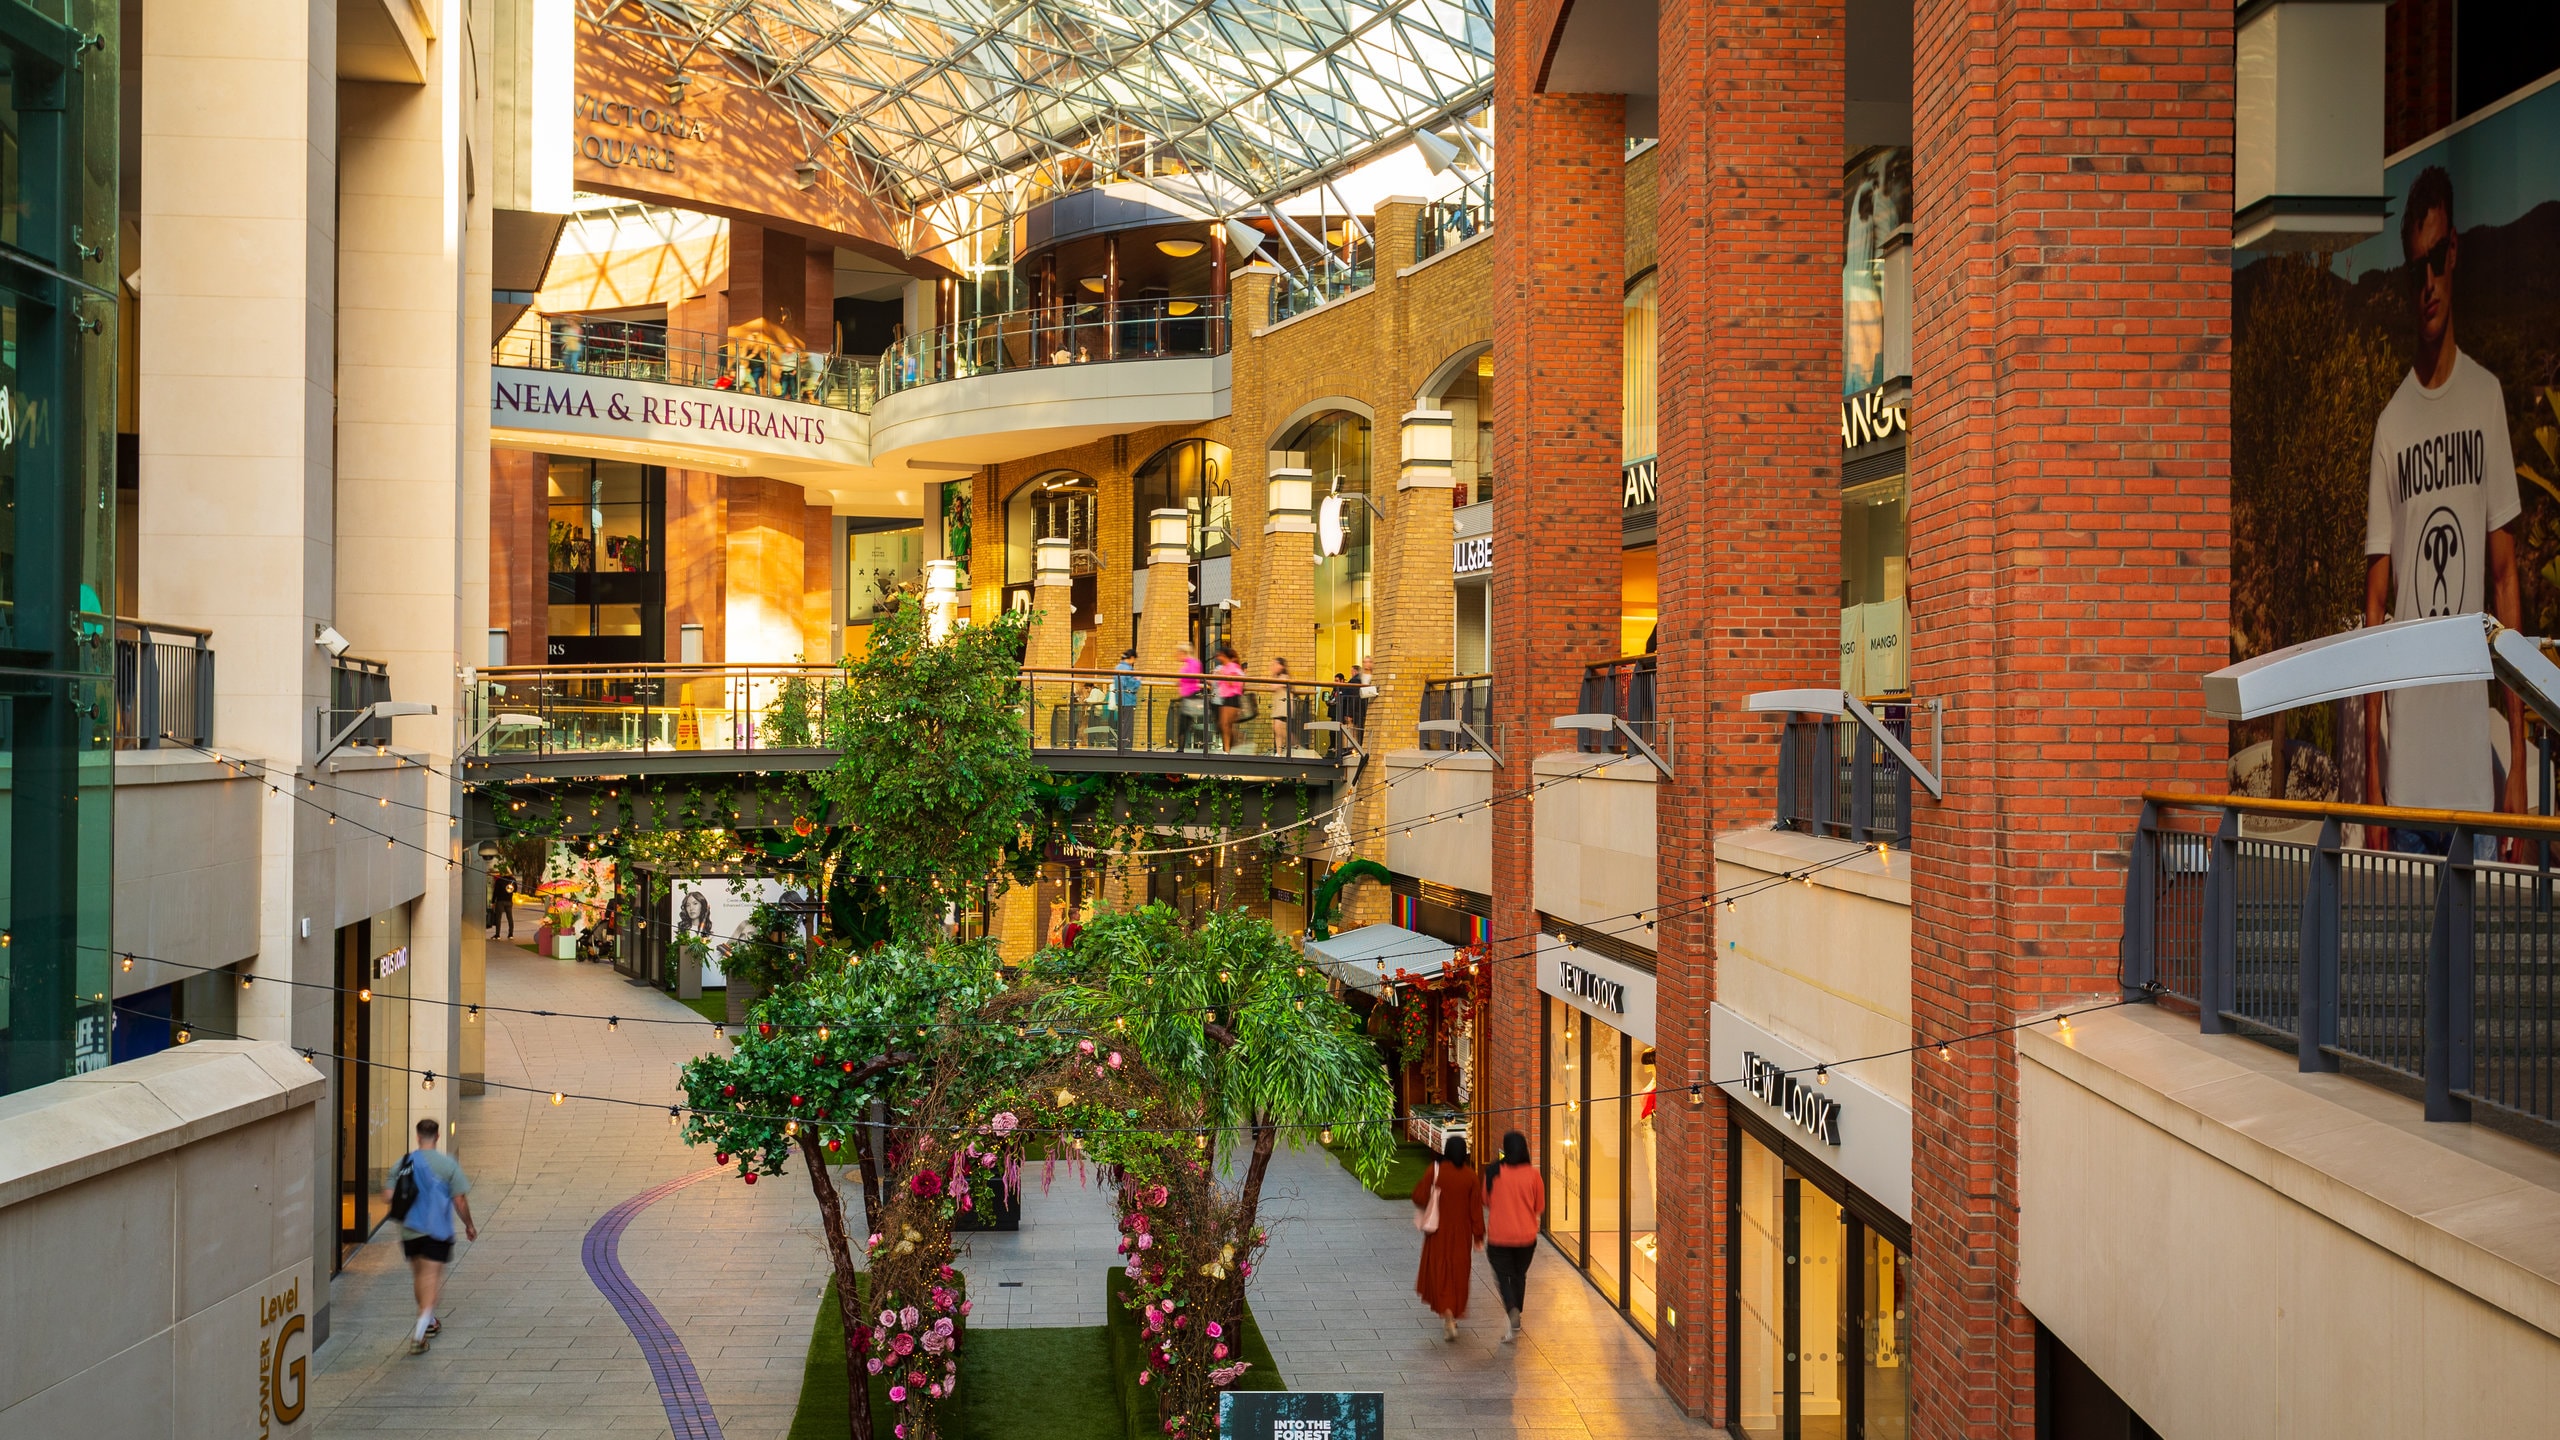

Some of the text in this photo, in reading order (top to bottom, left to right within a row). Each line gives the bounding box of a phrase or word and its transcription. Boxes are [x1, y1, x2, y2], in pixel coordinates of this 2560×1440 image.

[574, 94, 705, 142] VICTORIA
[494, 381, 825, 444] NEMA & RESTAURANTS
[1624, 461, 1658, 509] AN
[2397, 429, 2484, 504] MOSCHINO
[549, 644, 565, 655] RS
[1870, 634, 1897, 651] MANGO
[1559, 962, 1619, 1014] NEW LOOK
[1742, 1051, 1833, 1146] NEW LOOK
[260, 1276, 298, 1328] Level
[259, 1336, 270, 1440] LOWER
[272, 1314, 306, 1425] G
[1274, 1420, 1331, 1430] INTO THE
[1274, 1430, 1331, 1440] FOREST
